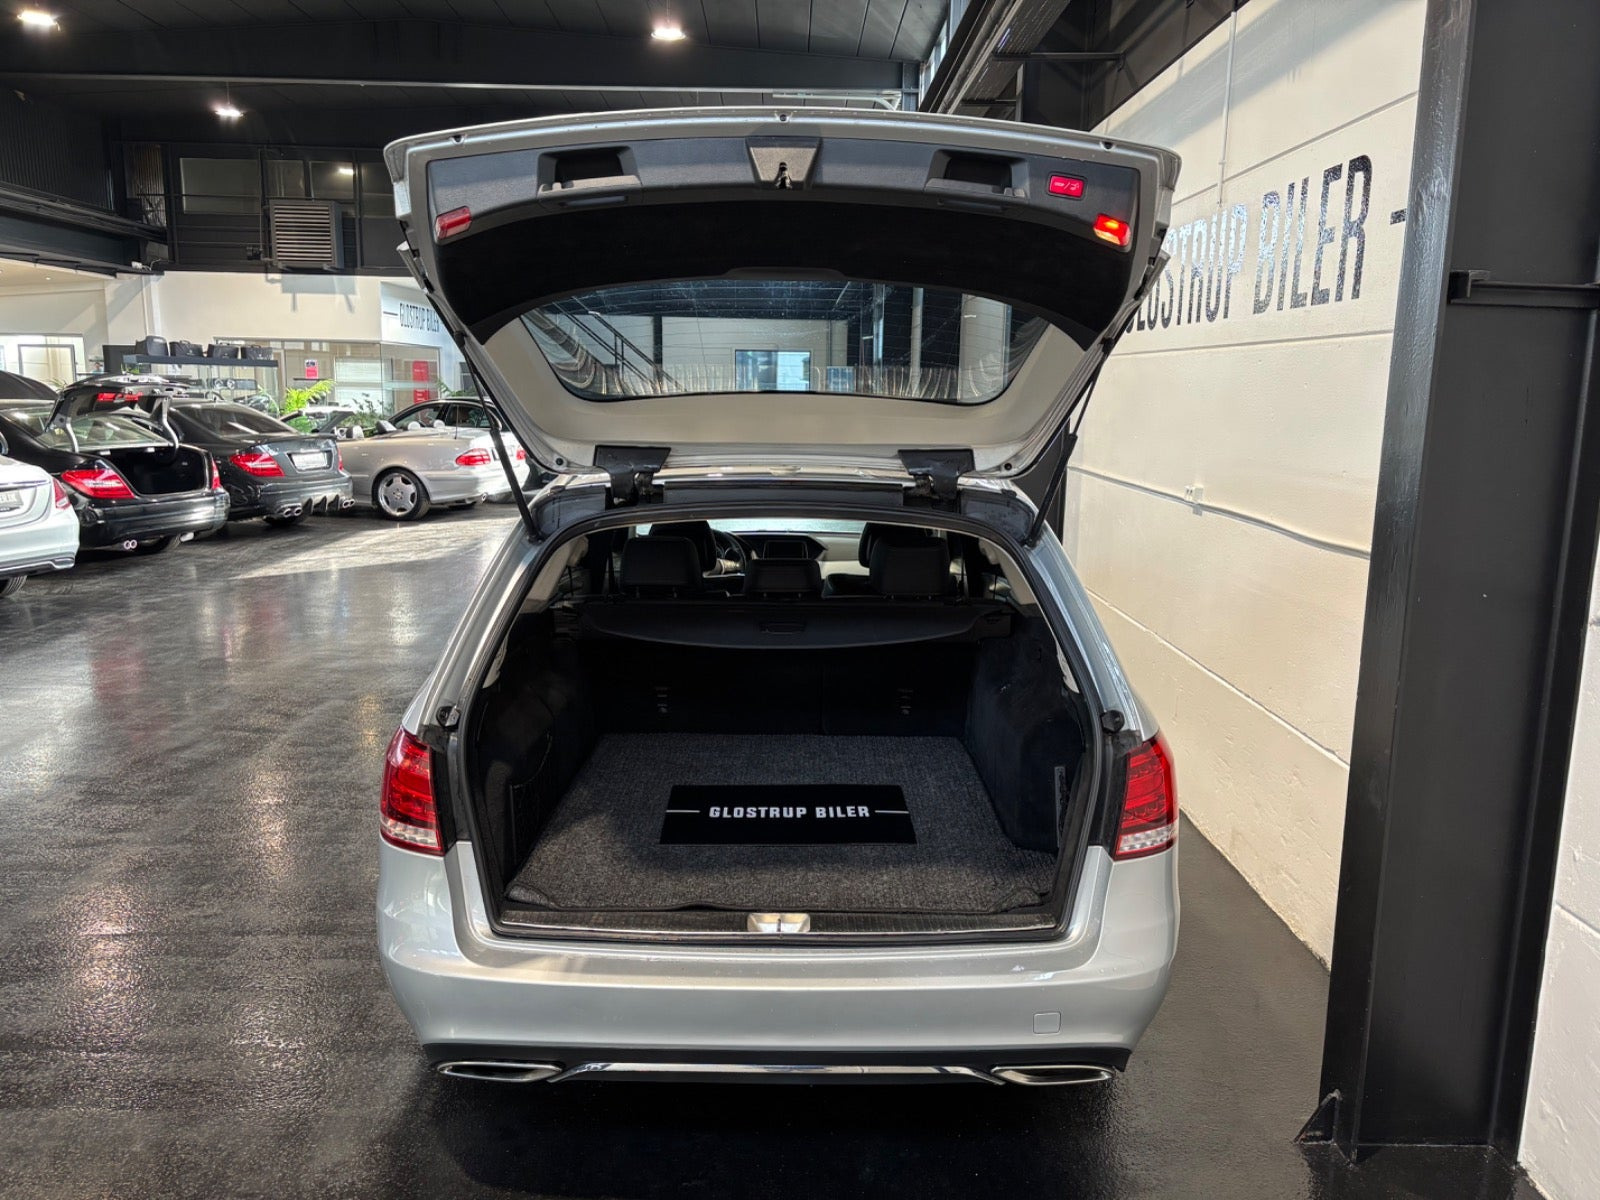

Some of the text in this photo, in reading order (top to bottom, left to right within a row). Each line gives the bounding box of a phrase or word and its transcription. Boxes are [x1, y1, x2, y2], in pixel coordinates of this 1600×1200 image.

[1126, 155, 1373, 334] STRUP BILER
[708, 805, 870, 819] GLOSTRUP BILER
